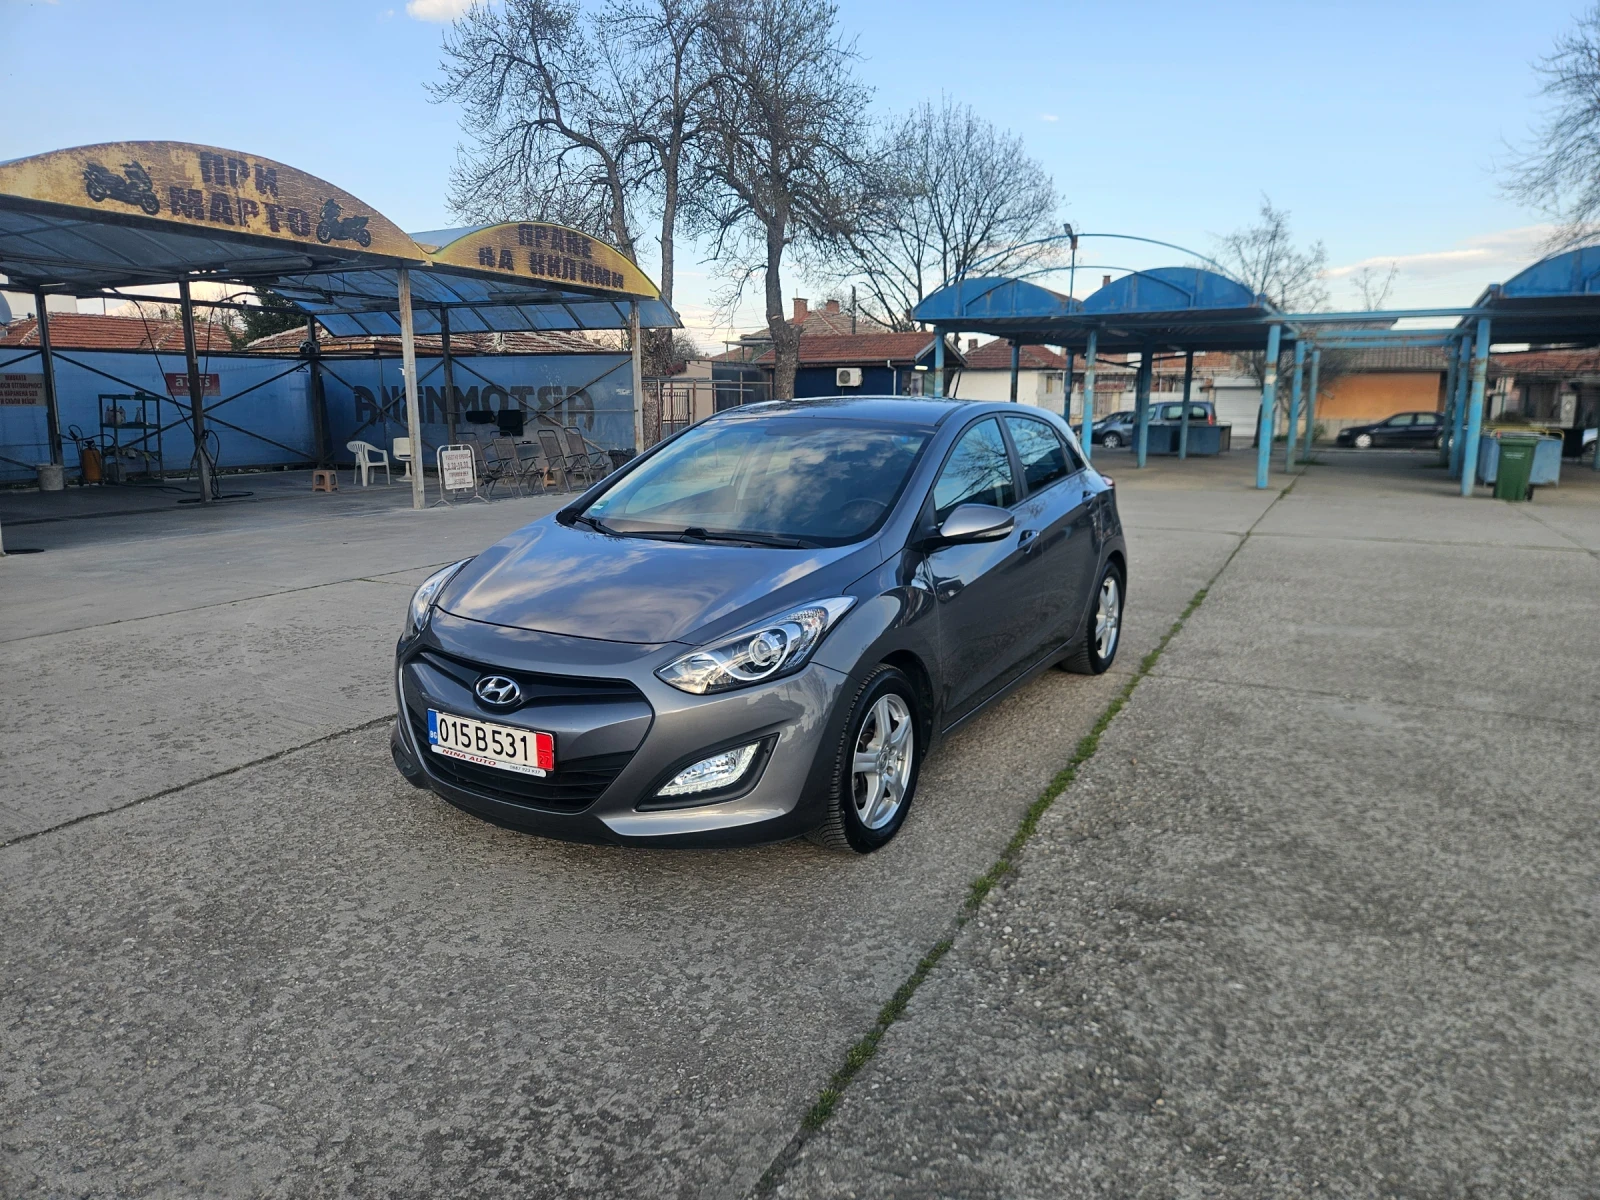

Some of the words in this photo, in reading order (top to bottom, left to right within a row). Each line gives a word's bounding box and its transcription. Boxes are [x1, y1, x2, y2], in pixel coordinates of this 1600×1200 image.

[200, 151, 278, 197] ПРИ
[169, 186, 311, 237] МАРТО
[518, 223, 592, 260] ПРАНЕ
[478, 246, 514, 271] НА
[530, 252, 624, 289] КИЛИМИ
[429, 731, 438, 740] BG
[442, 748, 466, 759] NINA
[469, 756, 497, 766] AUTO
[539, 755, 550, 765] 27
